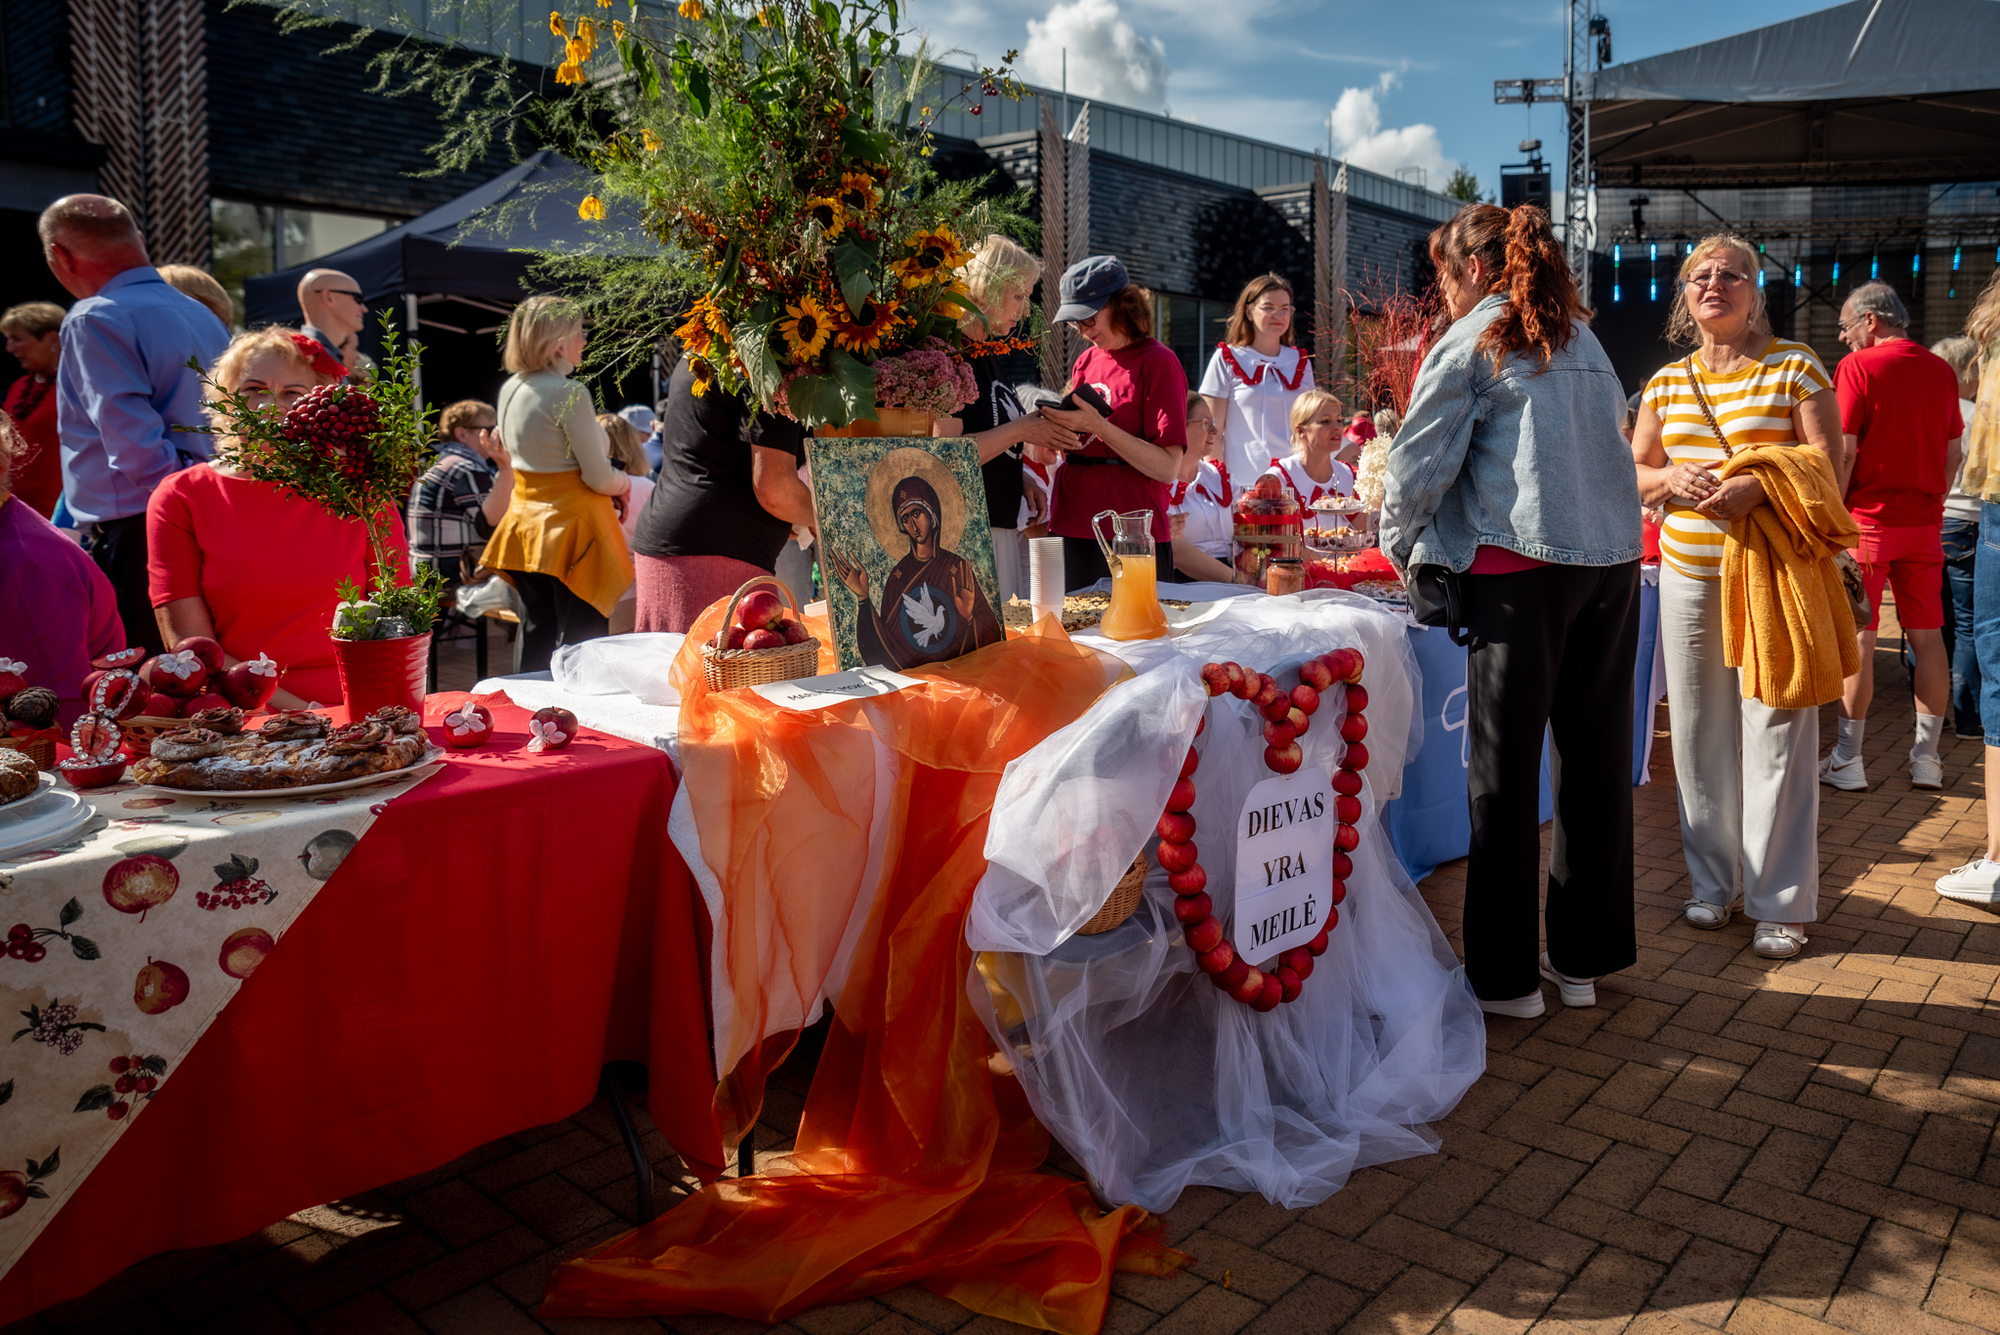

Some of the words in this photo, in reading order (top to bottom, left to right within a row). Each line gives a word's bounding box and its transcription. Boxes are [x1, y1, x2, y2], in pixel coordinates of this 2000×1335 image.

[1247, 791, 1325, 838] DIEVAS
[1263, 851, 1306, 887] YRA
[1249, 893, 1317, 951] MEILĖ
